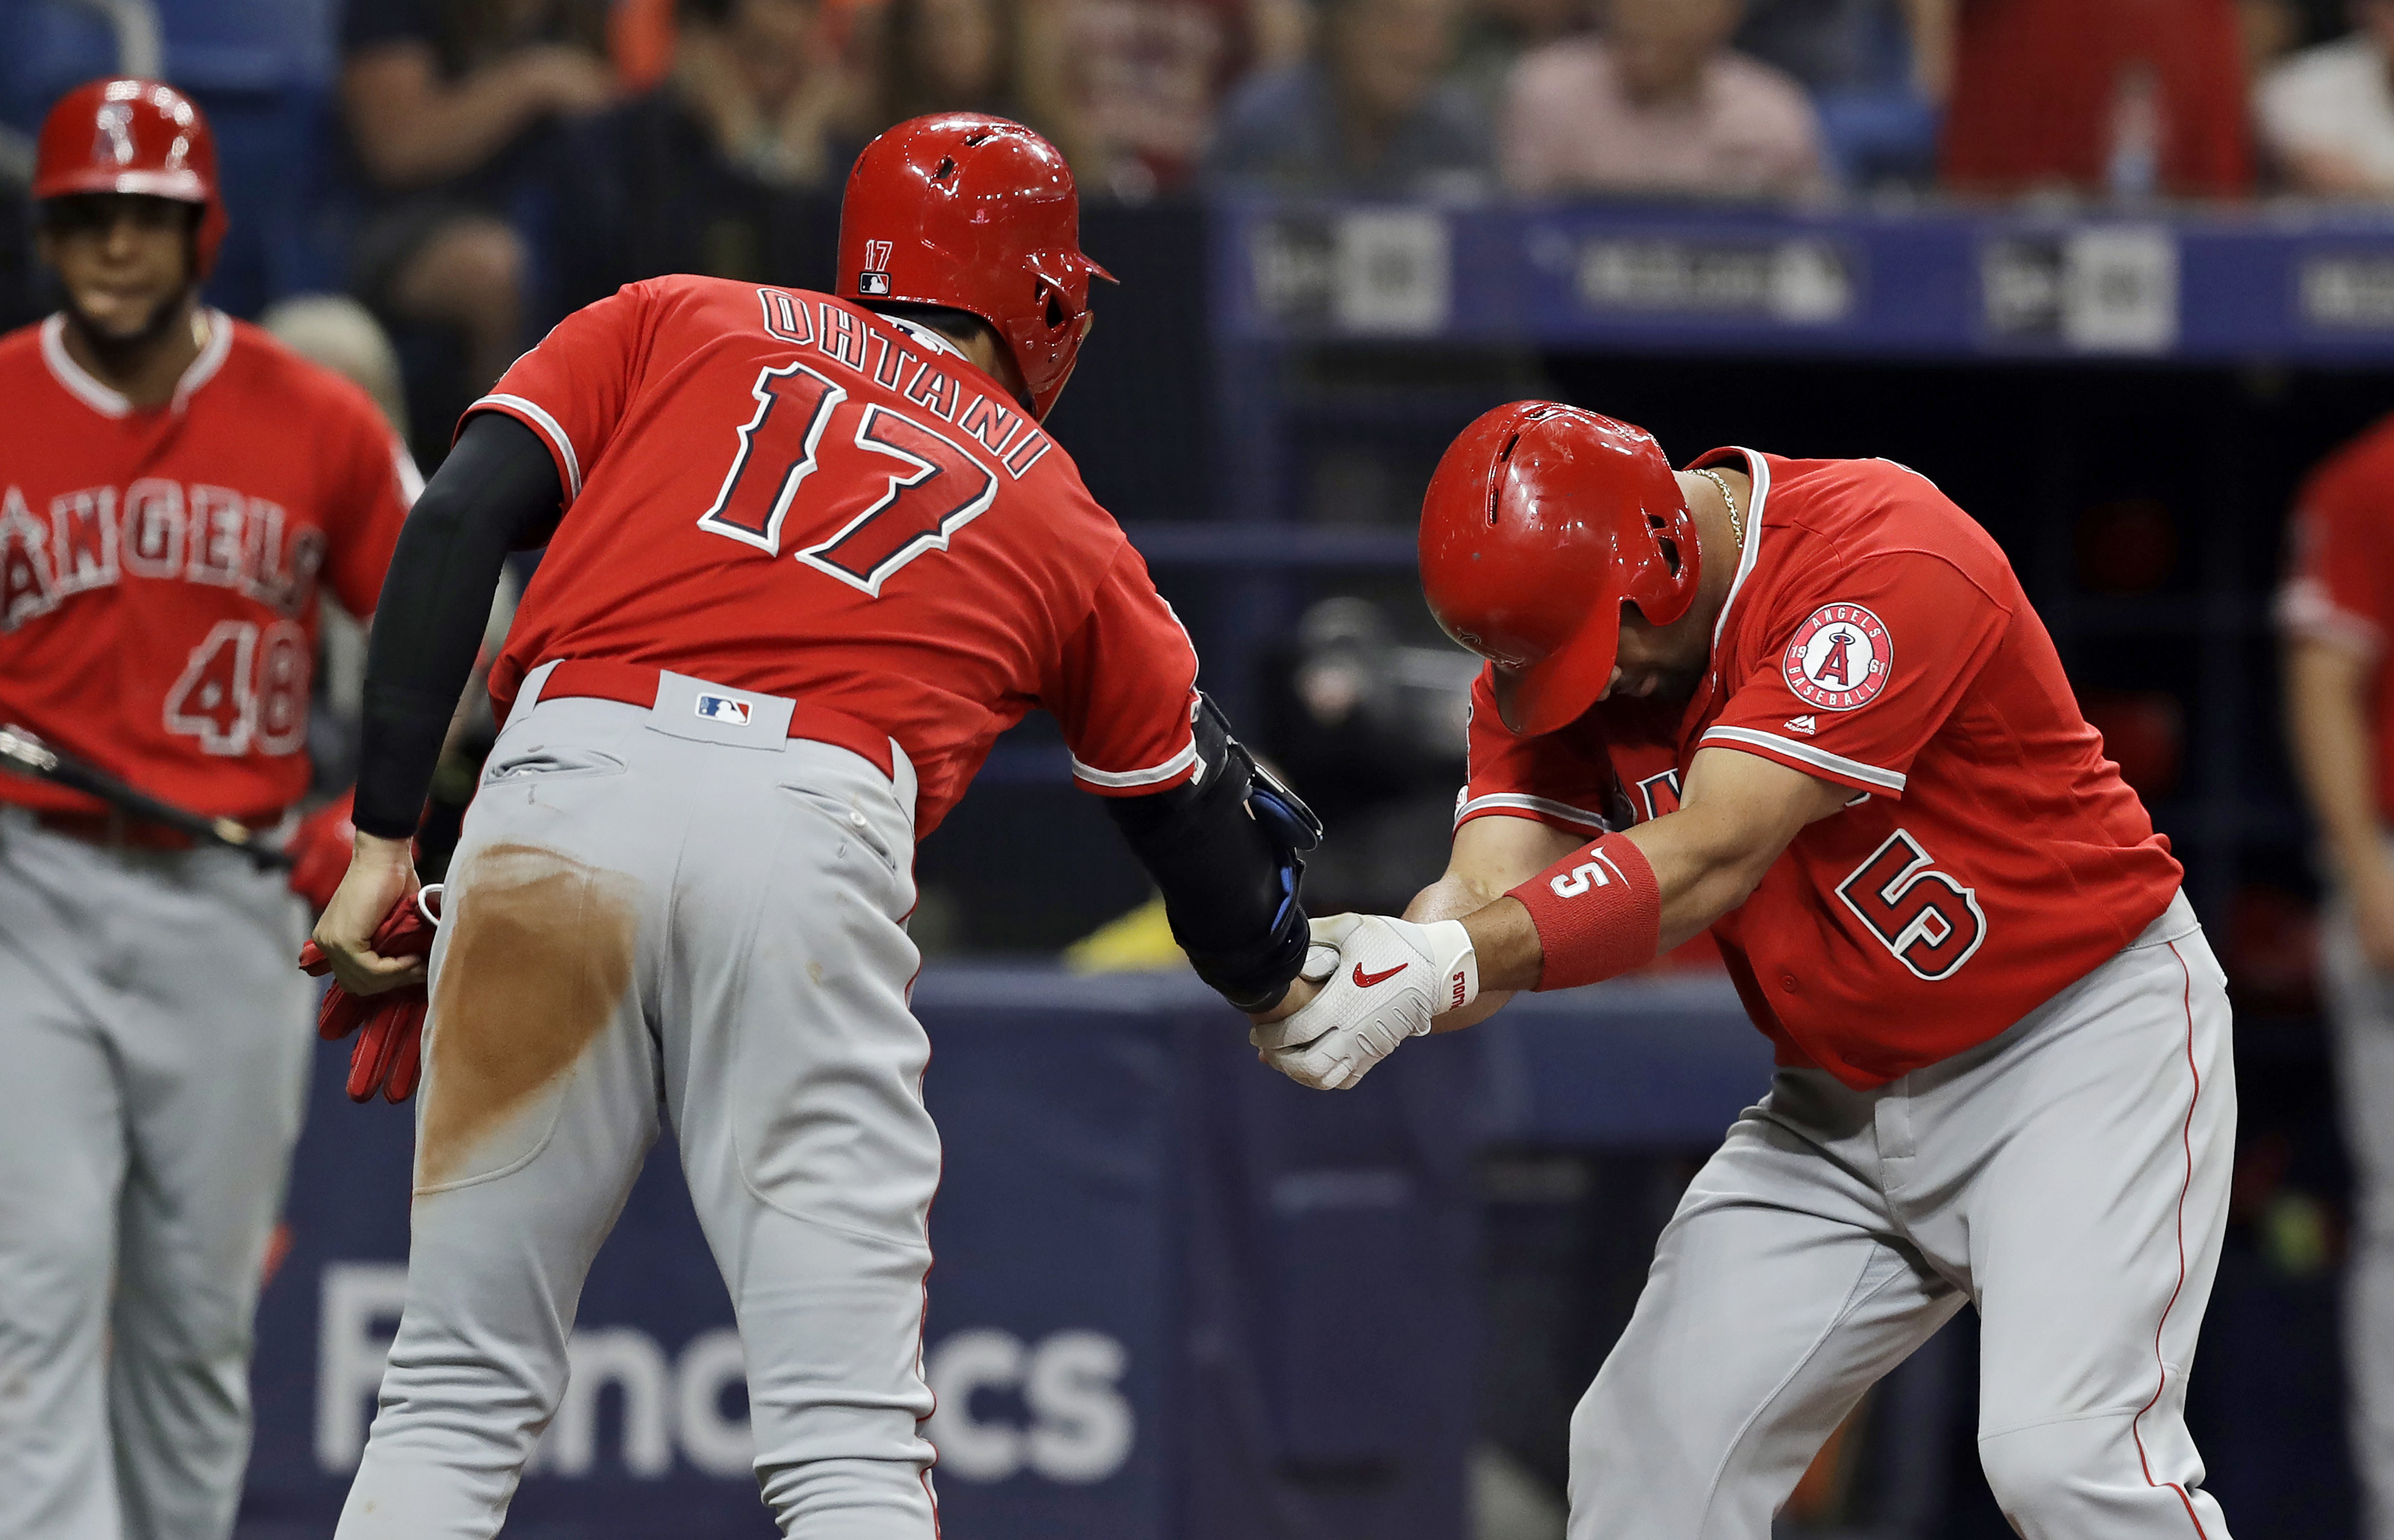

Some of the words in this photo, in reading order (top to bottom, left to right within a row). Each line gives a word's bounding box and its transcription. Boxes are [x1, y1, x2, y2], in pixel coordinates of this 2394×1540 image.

[865, 239, 893, 272] 17
[756, 288, 1052, 480] OHTANI
[697, 361, 999, 599] 17
[1811, 606, 1882, 638] ANGELS
[1790, 645, 1808, 659] 19
[1868, 658, 1887, 677] 61
[163, 620, 311, 756] 48
[1788, 665, 1876, 706] BASEBALL
[1550, 862, 1610, 899] 5
[1835, 828, 1987, 981] 5
